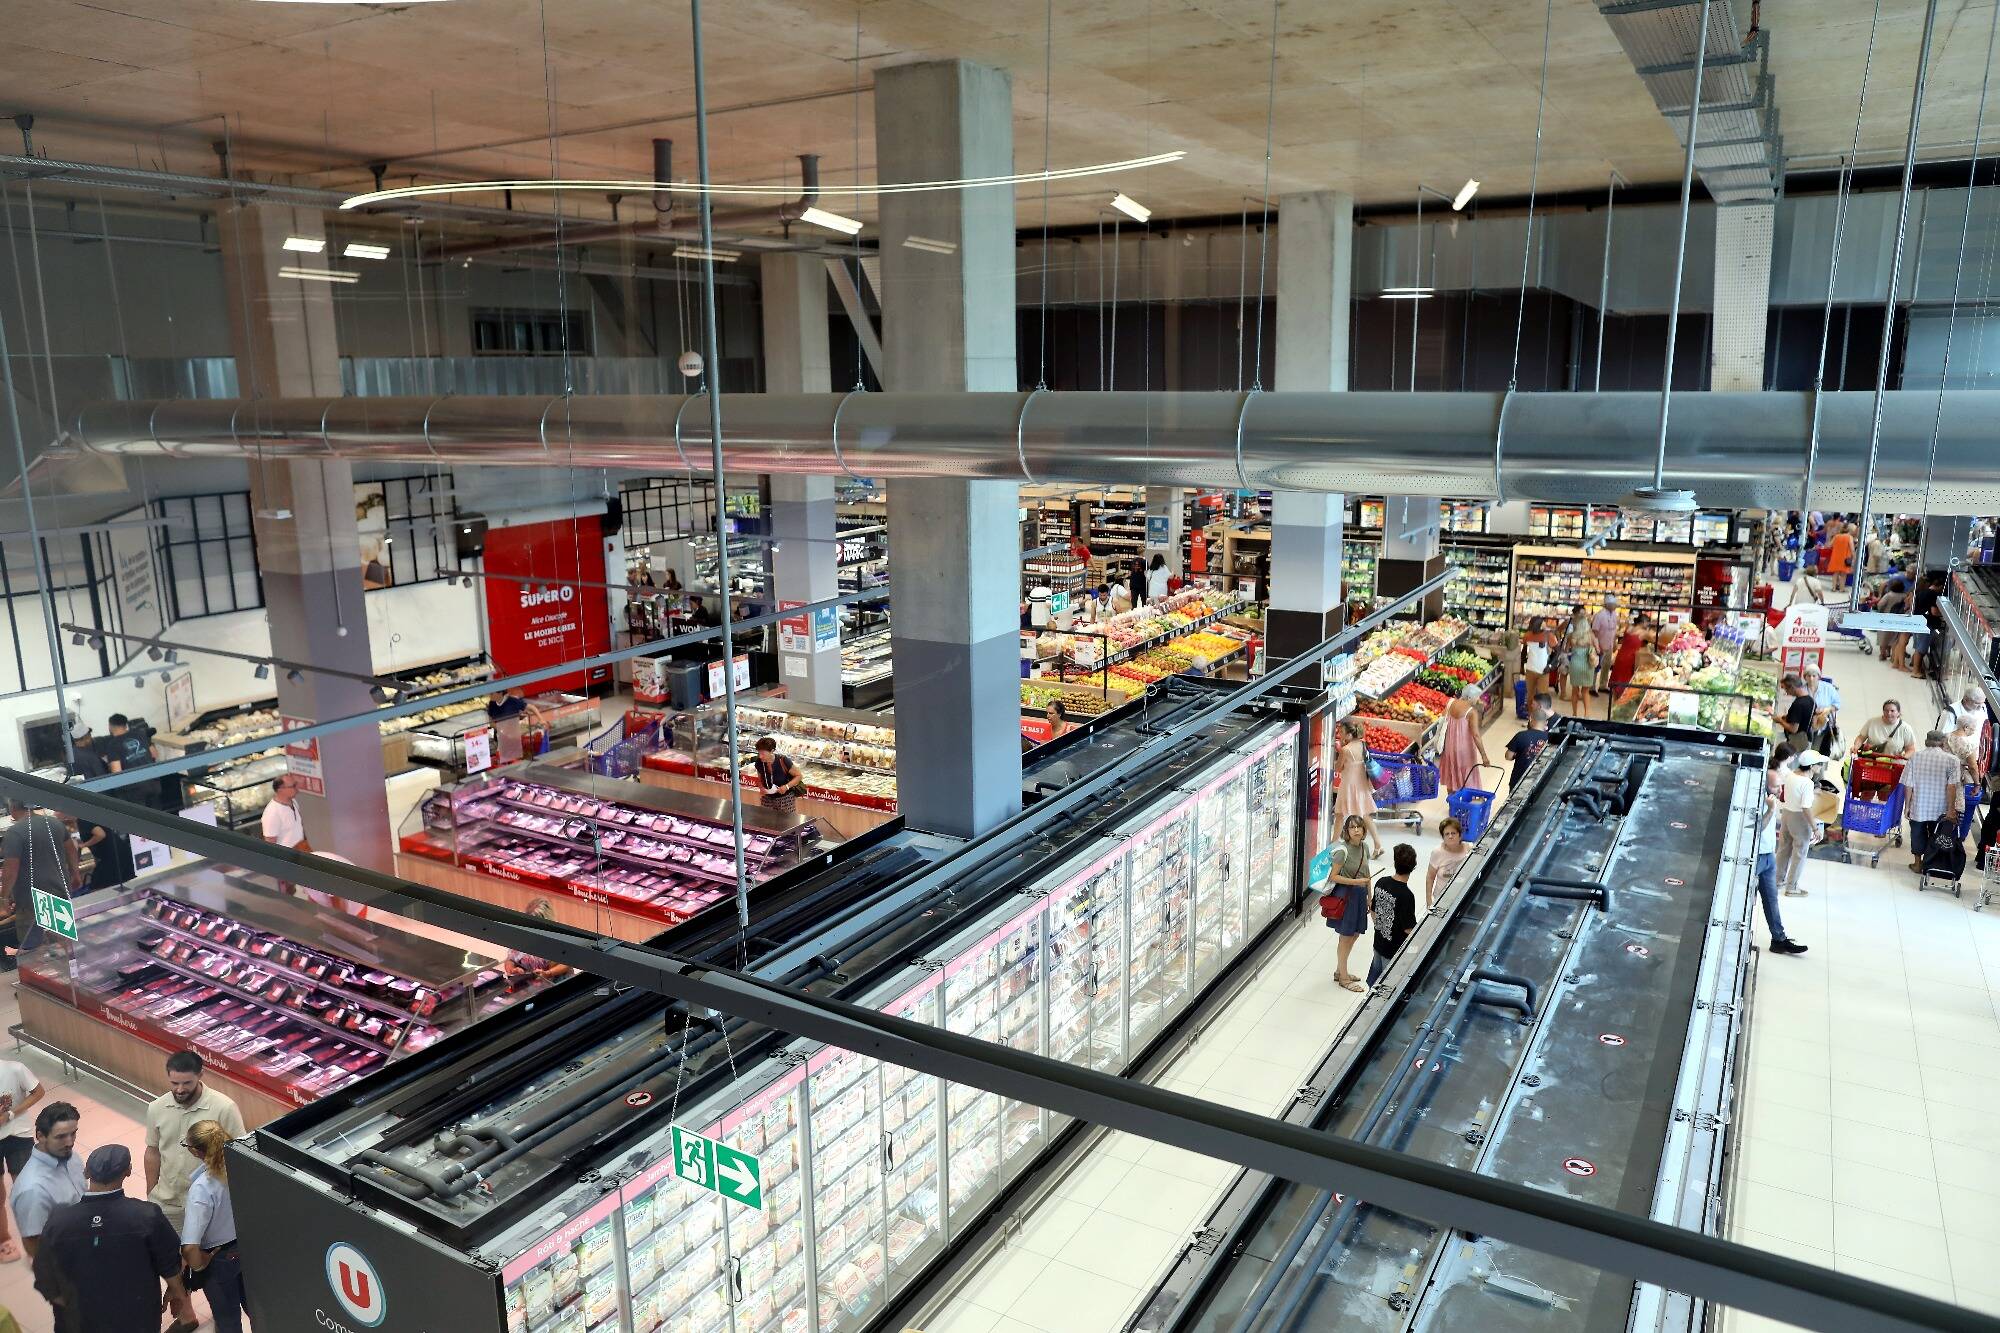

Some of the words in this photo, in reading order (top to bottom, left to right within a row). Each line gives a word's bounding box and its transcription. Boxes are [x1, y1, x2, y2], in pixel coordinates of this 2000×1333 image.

[520, 590, 559, 608] SUPER
[1794, 616, 1802, 626] 4
[524, 632, 533, 640] LE
[534, 626, 556, 638] MOINS
[538, 639, 548, 647] DE
[806, 788, 840, 802] harcuterie
[489, 862, 520, 881] Boucherie
[573, 884, 607, 904] Boucherie
[106, 1008, 137, 1031] Boucherie
[536, 1241, 554, 1258] Rôti
[556, 1236, 562, 1244] &
[564, 1216, 590, 1240] haché
[338, 1260, 370, 1308] U
[316, 1308, 354, 1333] Com
